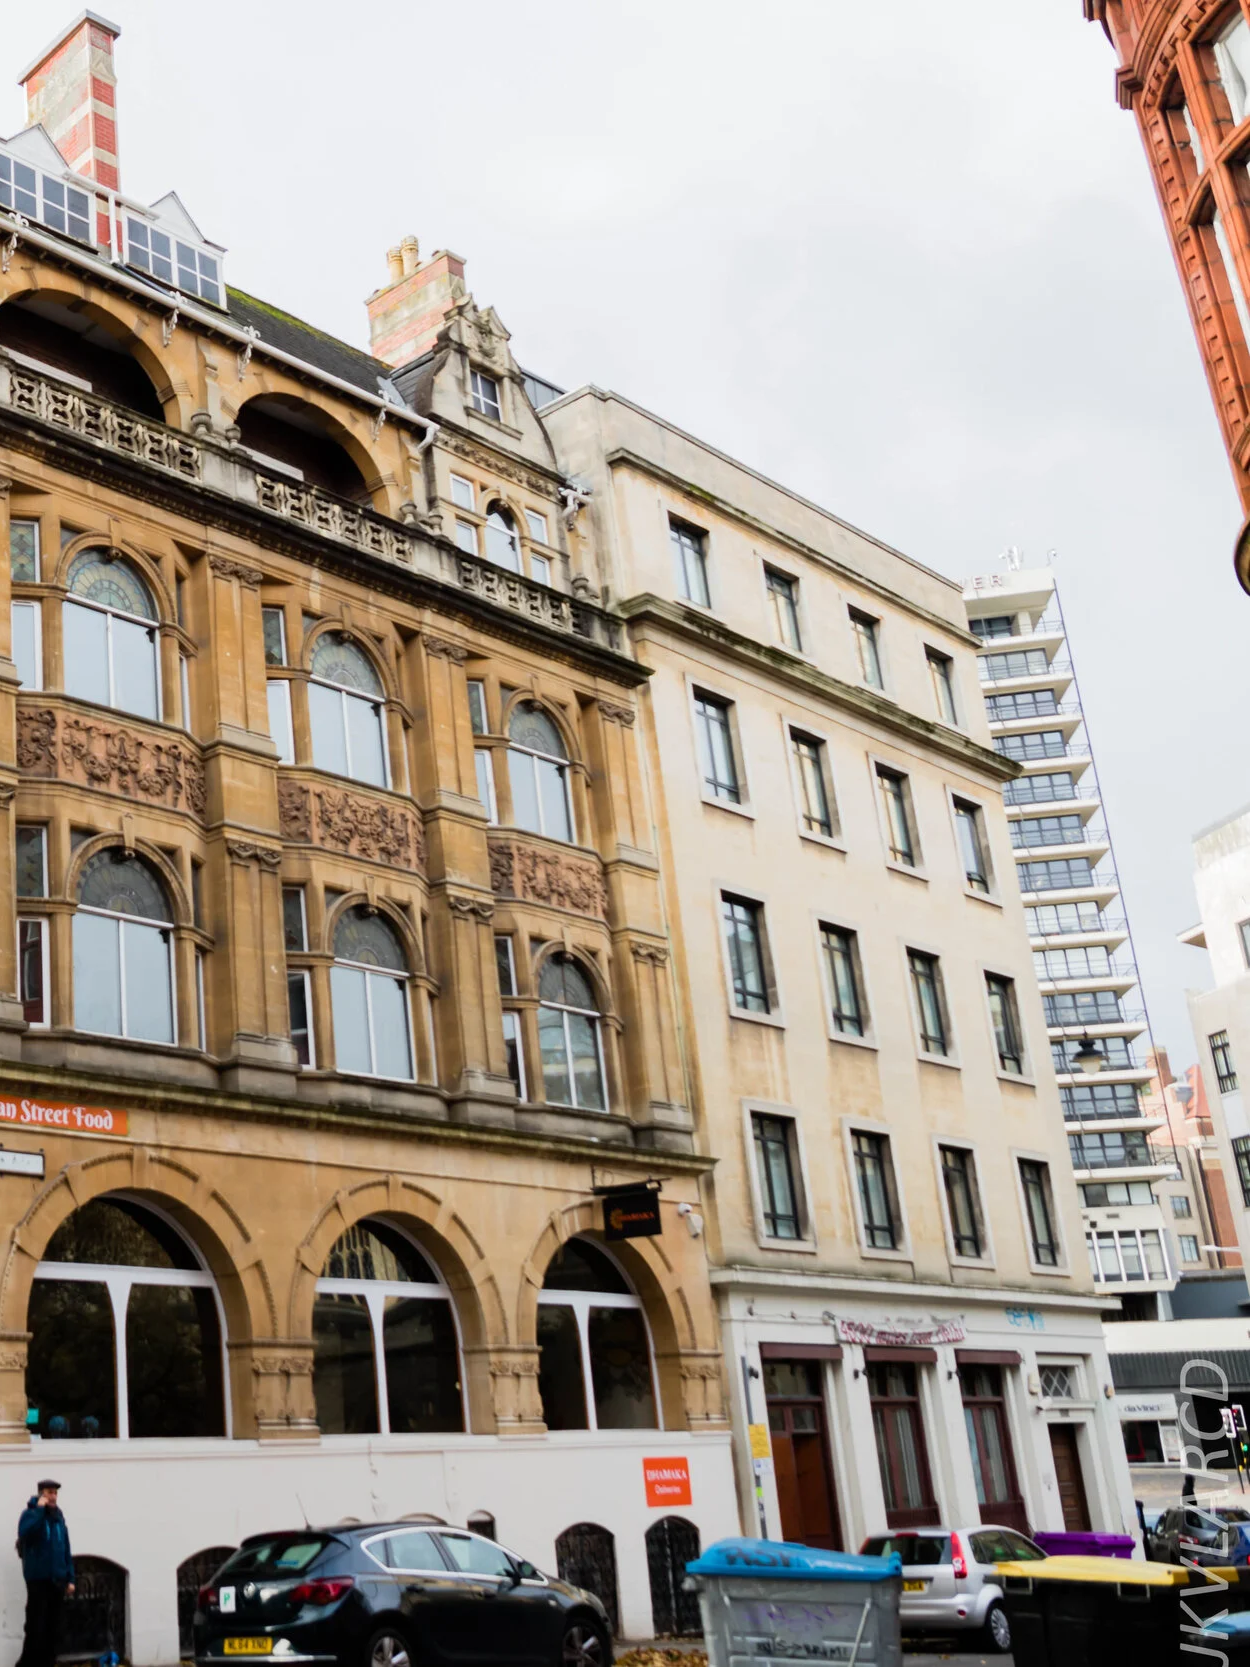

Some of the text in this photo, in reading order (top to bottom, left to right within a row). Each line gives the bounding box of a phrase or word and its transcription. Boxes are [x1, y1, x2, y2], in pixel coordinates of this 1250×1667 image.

[20, 1099, 70, 1125] Street
[72, 1106, 113, 1130] Food
[646, 1469, 688, 1481] DHAMAKA
